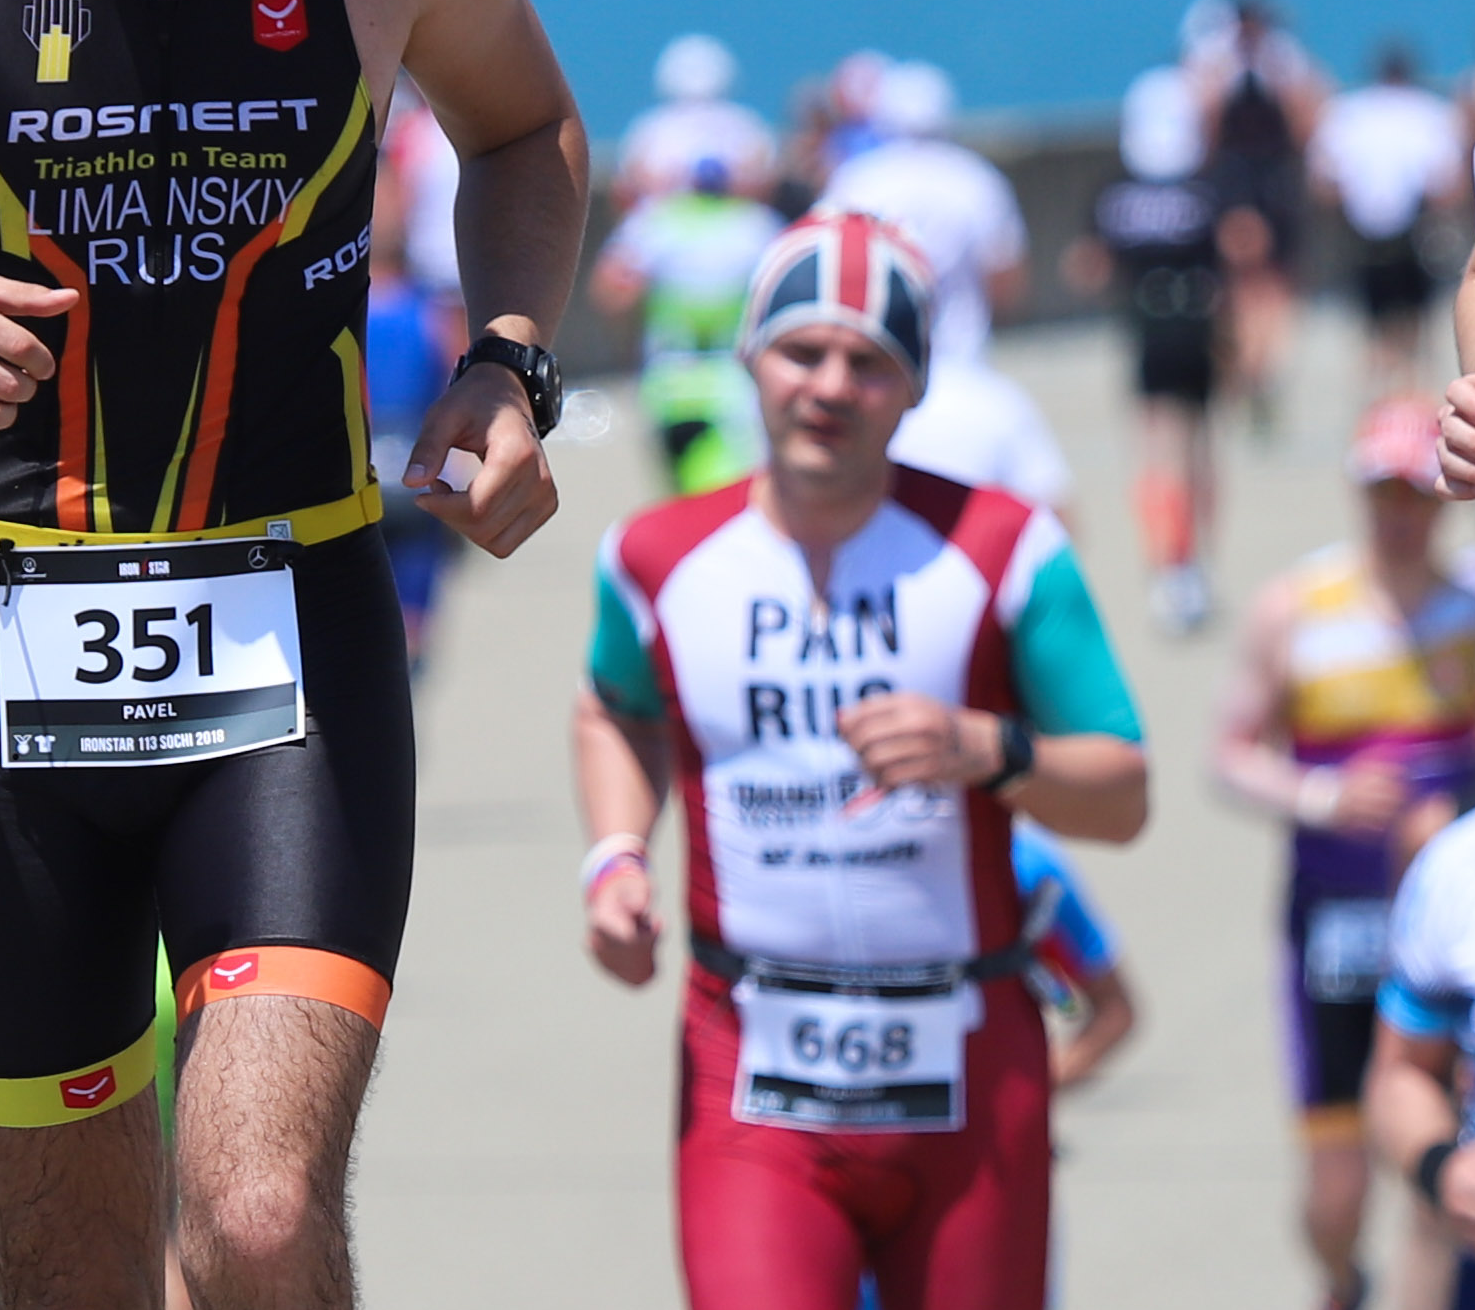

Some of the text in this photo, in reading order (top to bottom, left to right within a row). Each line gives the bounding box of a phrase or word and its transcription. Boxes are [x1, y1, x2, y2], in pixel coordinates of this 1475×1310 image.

[202, 146, 288, 169] Team
[88, 232, 225, 286] RUS
[74, 603, 215, 685] 351
[749, 583, 899, 661] PAN
[123, 701, 178, 720] PAVEL
[80, 728, 225, 752] IRONSTAR 113 SOCHI 2018
[793, 1016, 913, 1071] 668
